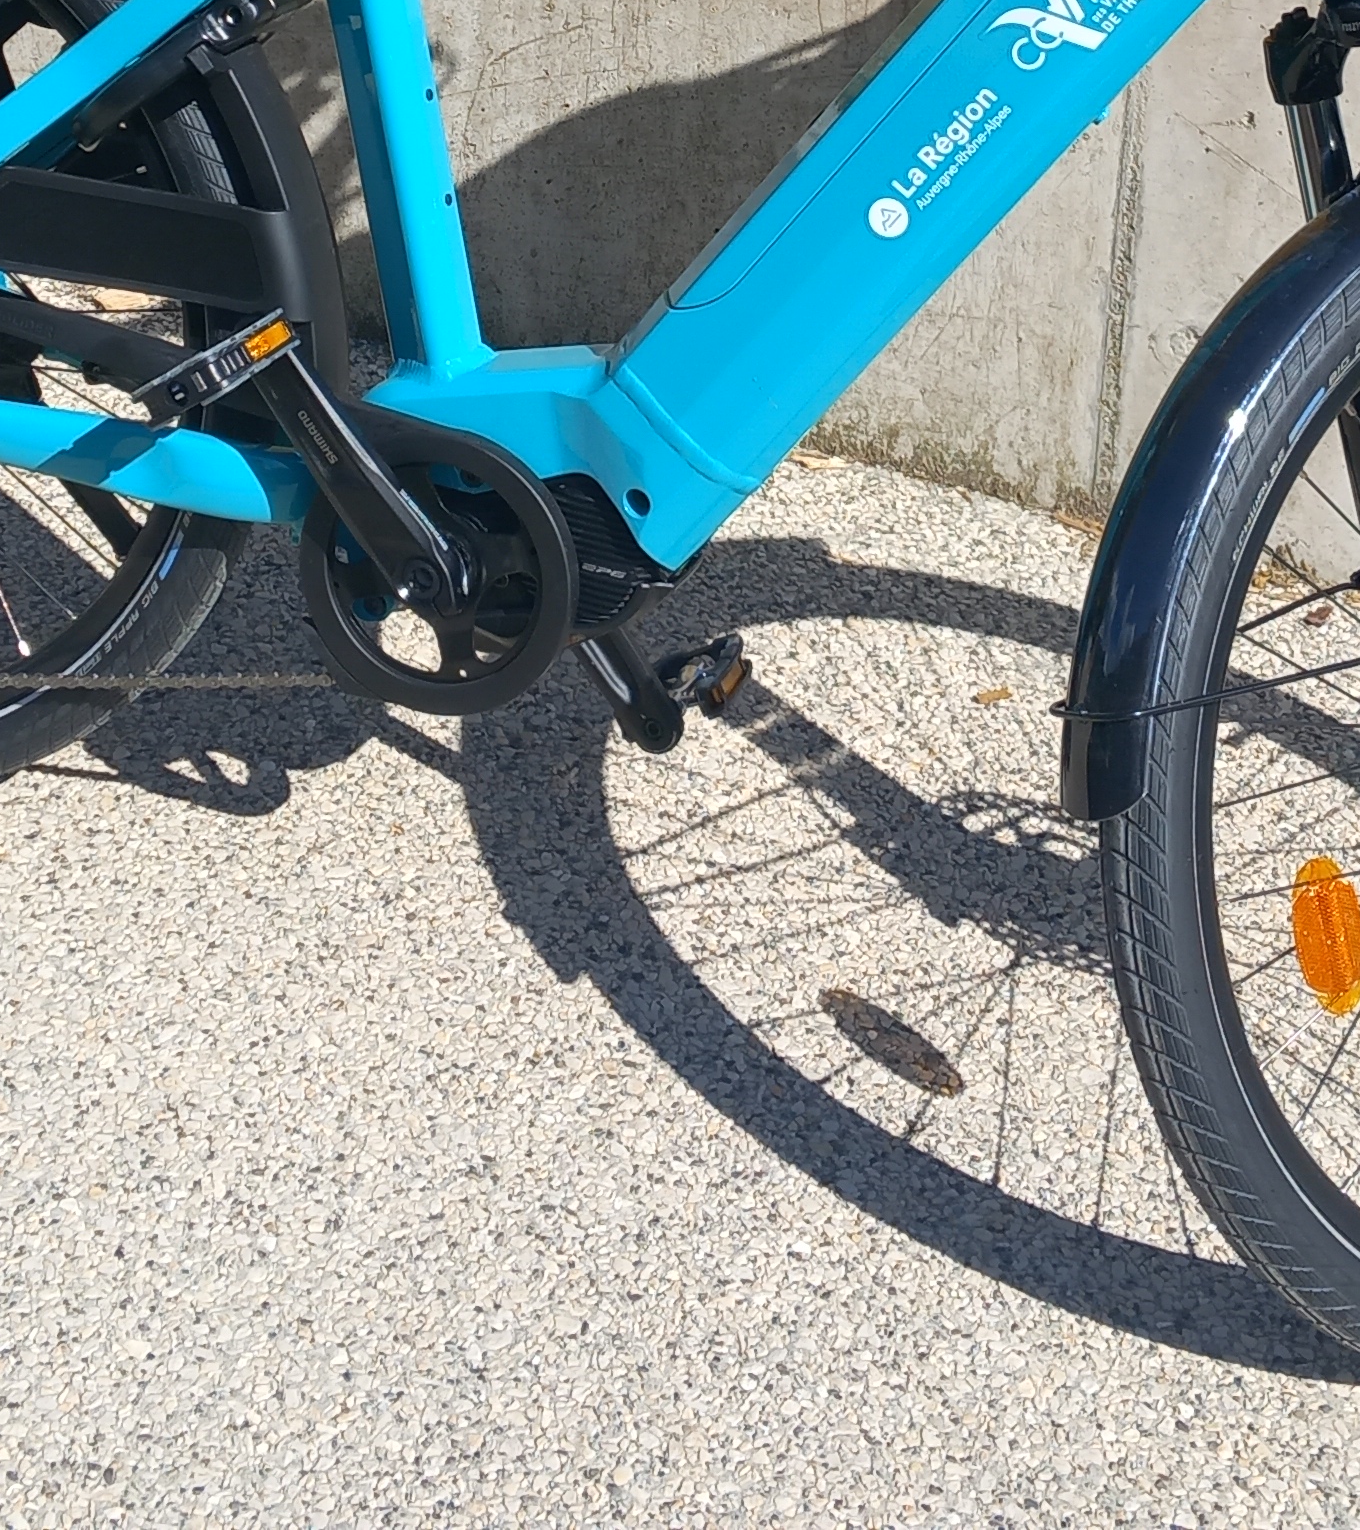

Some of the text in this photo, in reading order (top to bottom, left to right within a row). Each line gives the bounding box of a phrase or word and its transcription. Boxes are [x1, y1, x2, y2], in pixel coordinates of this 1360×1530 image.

[1101, 12, 1122, 33] DE
[891, 88, 998, 199] La Région
[916, 105, 1012, 211] Auvergne-Rhône-Alpes
[1329, 355, 1351, 387] BIG
[297, 410, 339, 465] SHIMANO
[104, 580, 159, 654] BIG APPLE
